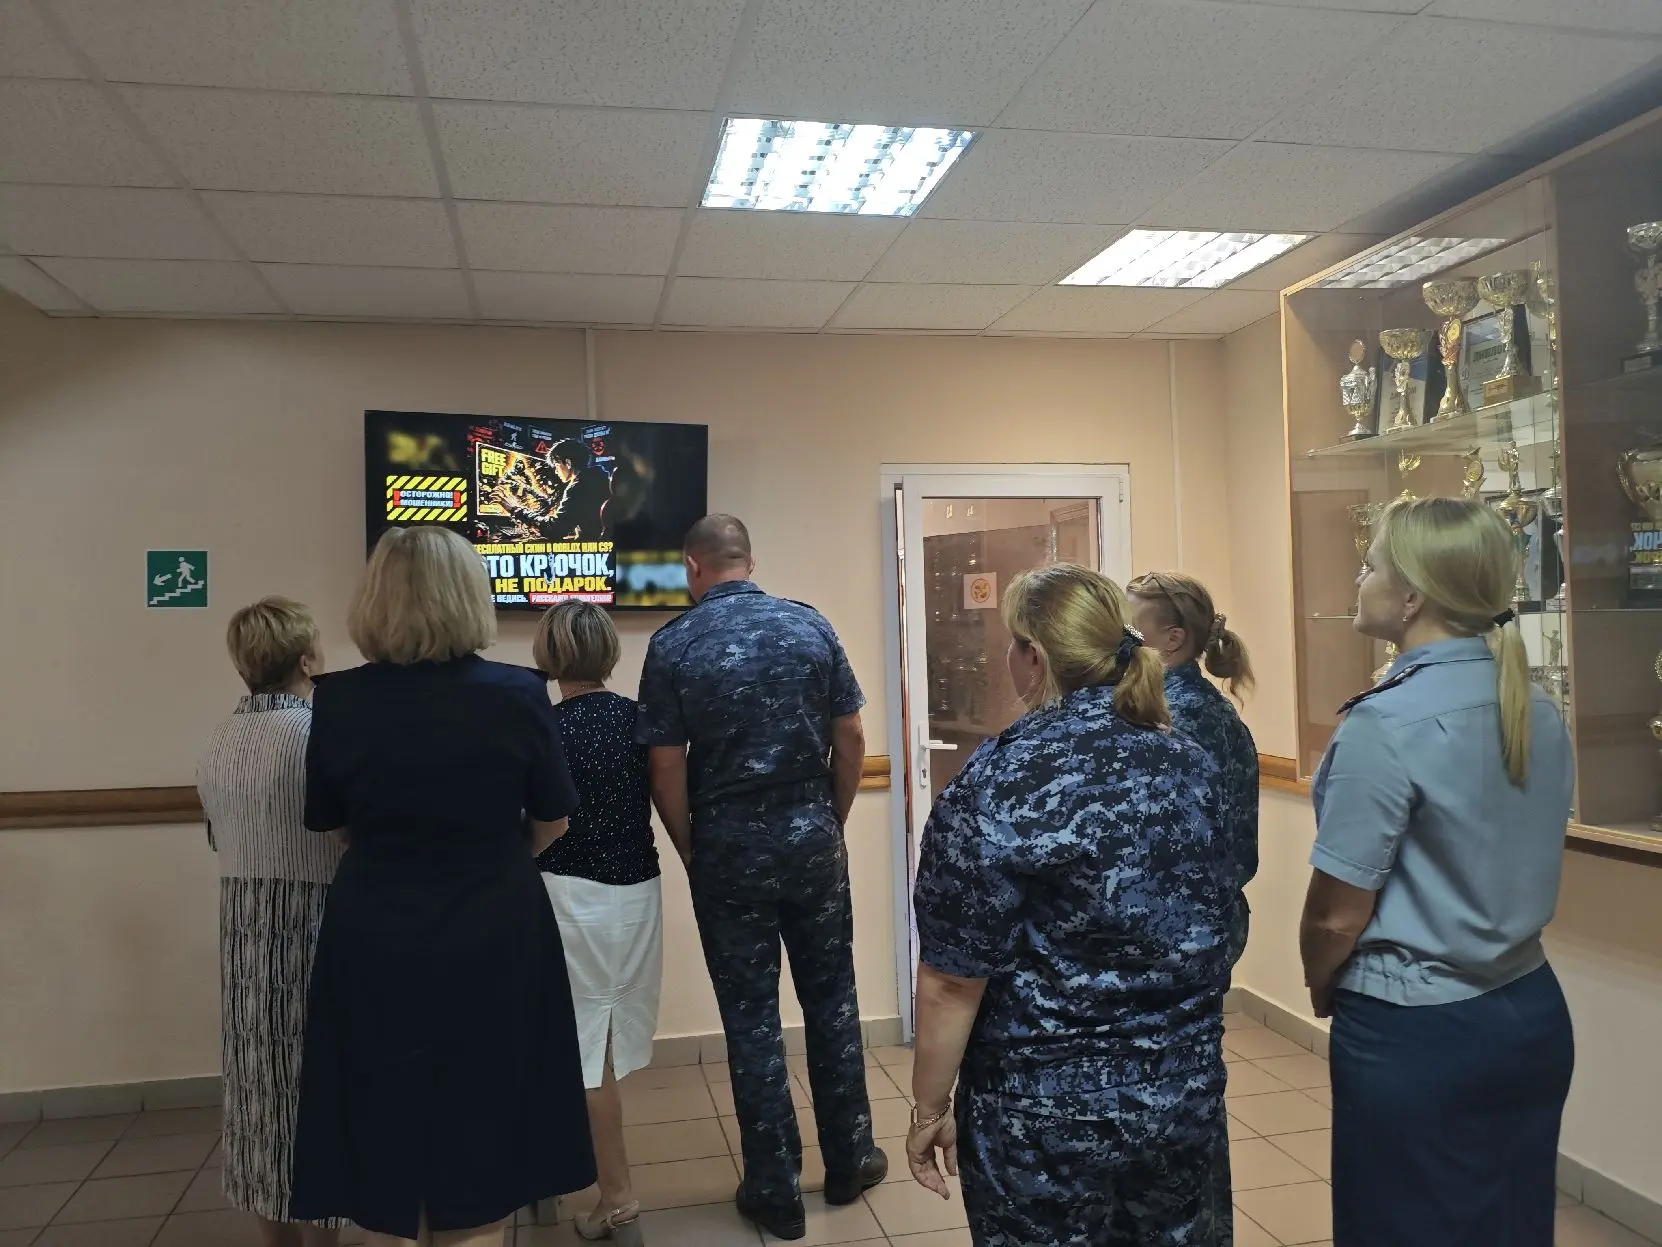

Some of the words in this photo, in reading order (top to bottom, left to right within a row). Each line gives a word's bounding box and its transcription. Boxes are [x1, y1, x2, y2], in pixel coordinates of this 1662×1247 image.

[481, 448, 507, 467] FREE
[482, 462, 504, 477] GIFT
[400, 490, 453, 499] ОСТОРОЖНО!
[525, 543, 546, 554] СКИН
[553, 543, 581, 553] ROBLOX
[581, 542, 598, 553] ИЛИ
[598, 541, 614, 553] CS?
[484, 555, 514, 578] ТО
[495, 578, 519, 593] НЕ
[523, 576, 611, 593] ПОДАРОК.
